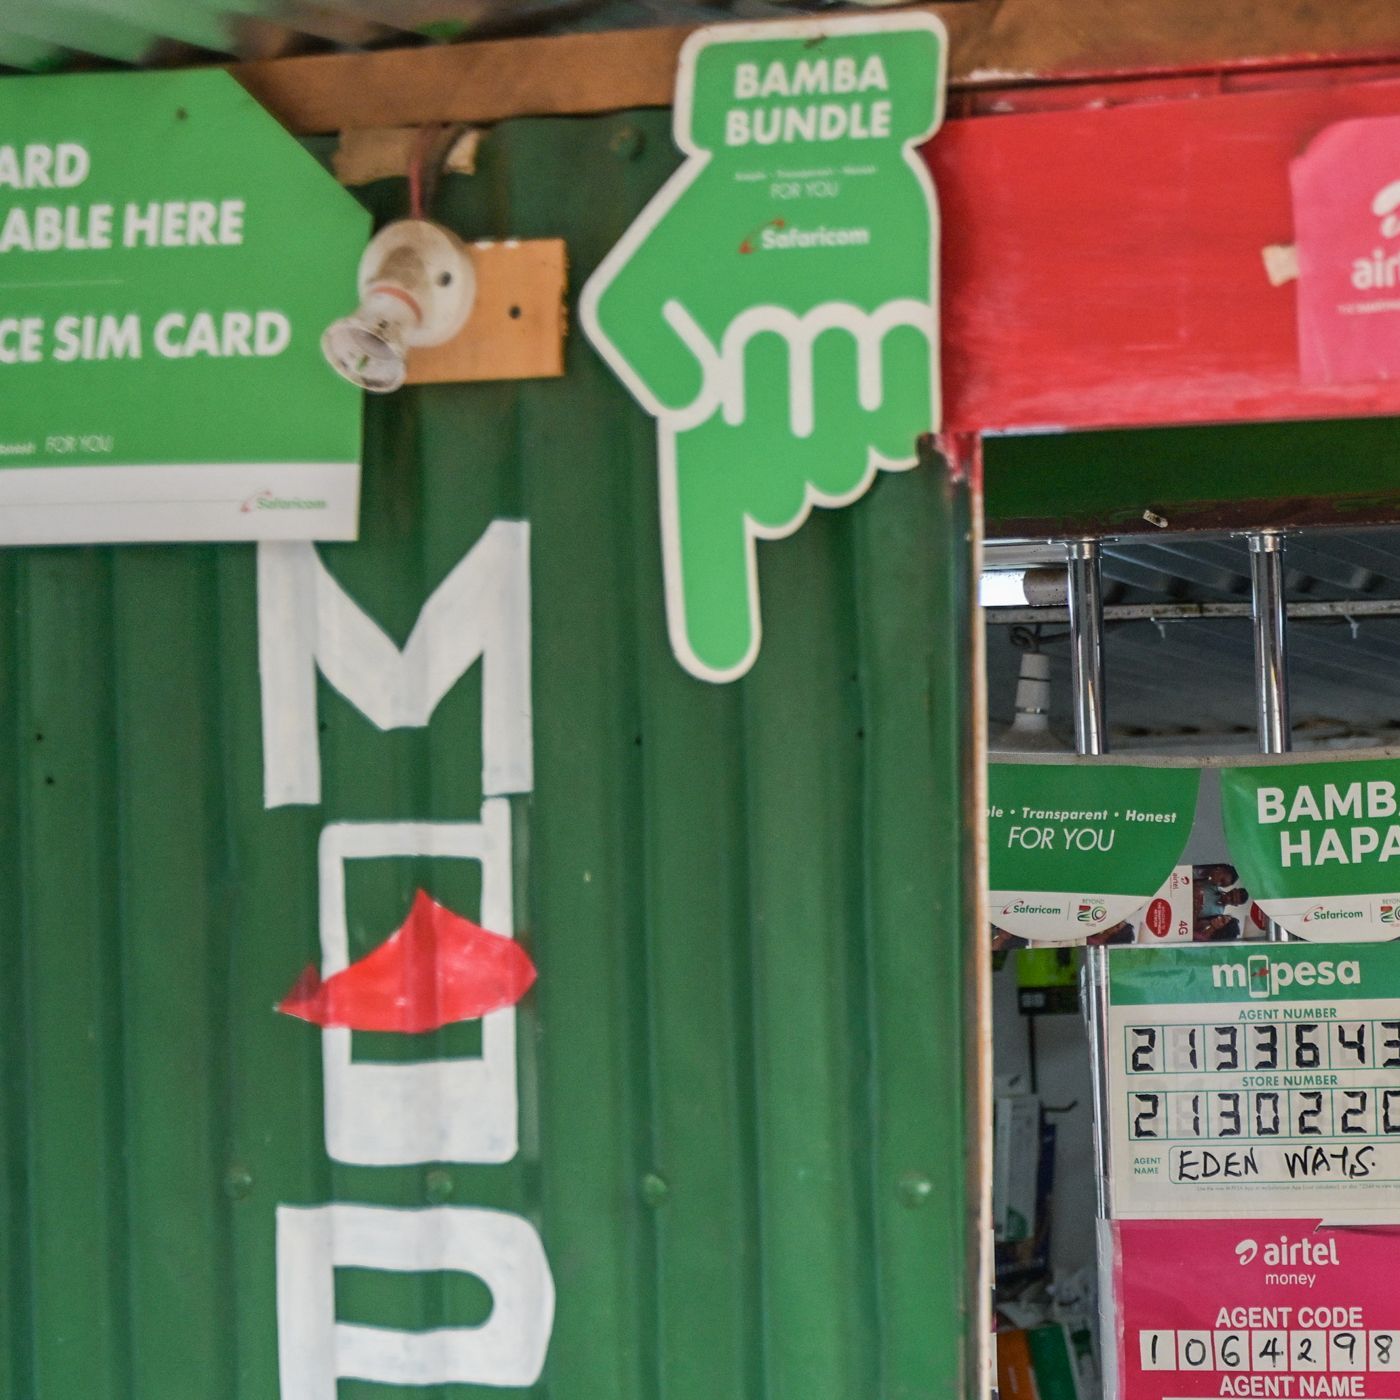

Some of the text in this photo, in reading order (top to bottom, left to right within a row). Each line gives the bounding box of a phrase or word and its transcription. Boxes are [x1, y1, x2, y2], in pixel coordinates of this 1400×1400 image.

[735, 55, 889, 99] BAMBA
[725, 101, 893, 146] BUNDLE
[0, 142, 91, 189] ARD
[770, 181, 839, 199] FOR YOU
[123, 199, 246, 249] HERE
[761, 226, 870, 249] Safaricom
[53, 313, 143, 362] SIM
[154, 310, 292, 358] CARD
[1022, 806, 1177, 824] Transparent Honest
[1007, 826, 1116, 852] FOR YOU
[1012, 902, 1062, 915] Safaricom
[1313, 908, 1365, 922] Safaricom
[1238, 1007, 1338, 1020] AGENT NUMBER
[1242, 1074, 1338, 1087] STORE NUMBER
[1133, 1157, 1162, 1166] AGENT
[1133, 1165, 1160, 1175] NAME
[1178, 1147, 1259, 1180] EDEN
[1263, 1235, 1340, 1266] airtel
[1265, 1272, 1316, 1288] money
[1215, 1306, 1363, 1328] AGENT CODE
[1219, 1375, 1366, 1397] AGENT NAME
